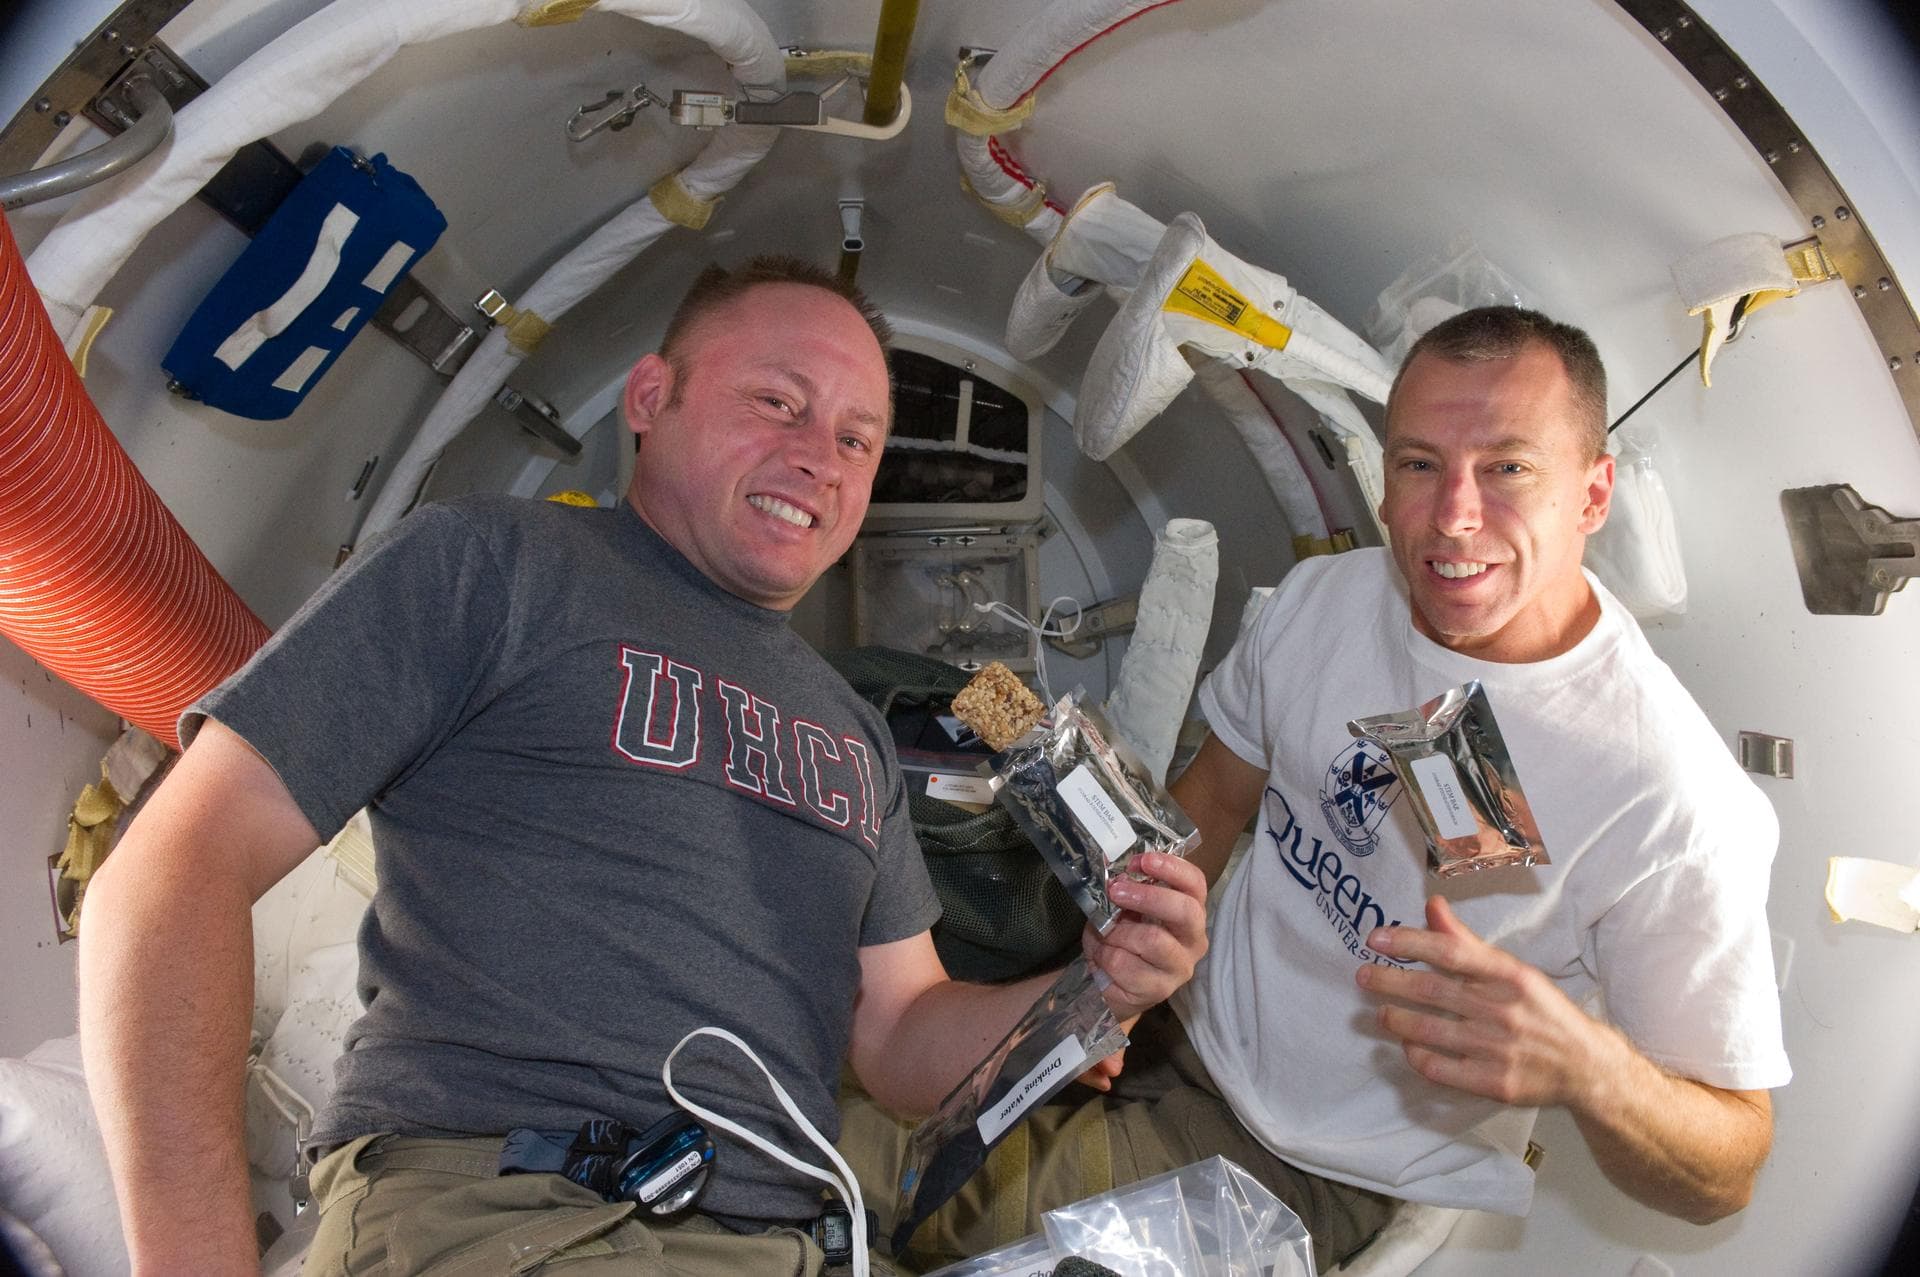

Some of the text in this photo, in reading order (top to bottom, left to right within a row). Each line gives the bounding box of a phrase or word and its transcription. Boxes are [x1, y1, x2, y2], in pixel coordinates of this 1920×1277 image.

[1264, 785, 1418, 964] Queen'
[1000, 1057, 1062, 1120] Drinking Water
